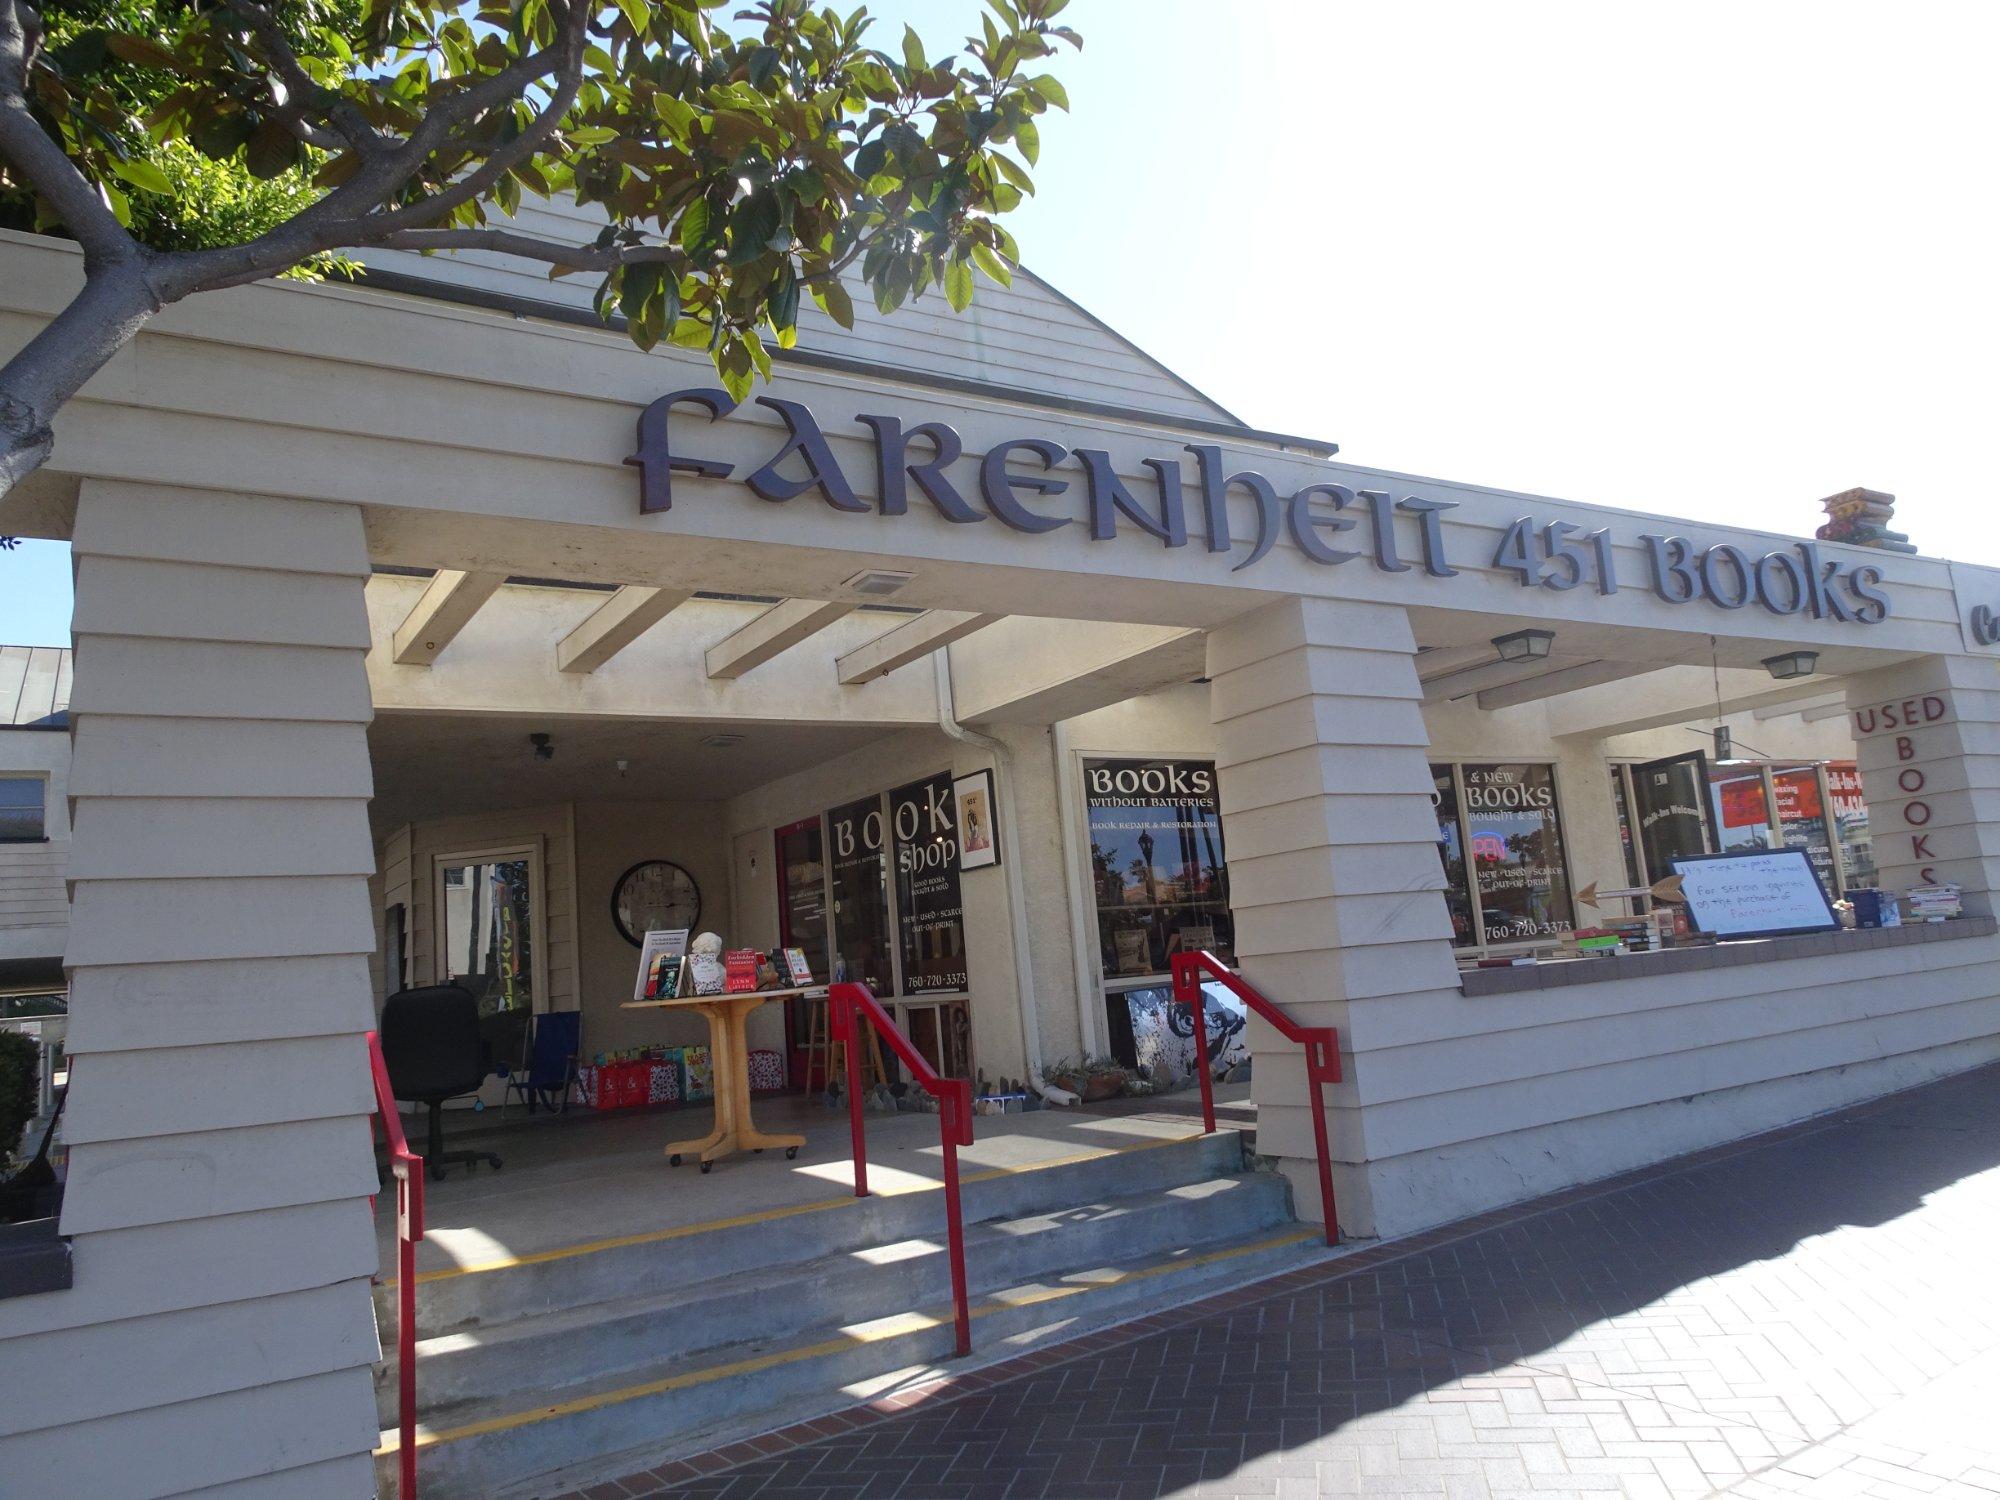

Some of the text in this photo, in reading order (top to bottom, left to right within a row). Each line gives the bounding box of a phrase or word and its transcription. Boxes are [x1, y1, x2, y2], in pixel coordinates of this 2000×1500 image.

[623, 387, 1893, 625] FARENHEIT 451 BOOKS
[1971, 604, 2000, 645] C
[1856, 697, 1945, 733] USED
[1088, 765, 1211, 794] BOOKS
[1470, 771, 1514, 783] & NEW
[1090, 796, 1214, 808] WITHOUT BATTERIES
[1465, 783, 1552, 807] BOOKS
[834, 784, 954, 857] BOOK
[1467, 810, 1513, 822] BOUGHT
[1529, 808, 1555, 820] SOLD
[1896, 736, 1936, 885] BOOKS
[1092, 821, 1117, 830] BOOK
[1119, 821, 1151, 830] REPAIR
[1161, 821, 1217, 829] RESTORATION
[1478, 867, 1563, 879] NEW USED SCARCE
[920, 911, 936, 921] USED
[940, 907, 963, 918] SCARCE
[1485, 920, 1571, 940] 760-720-3373
